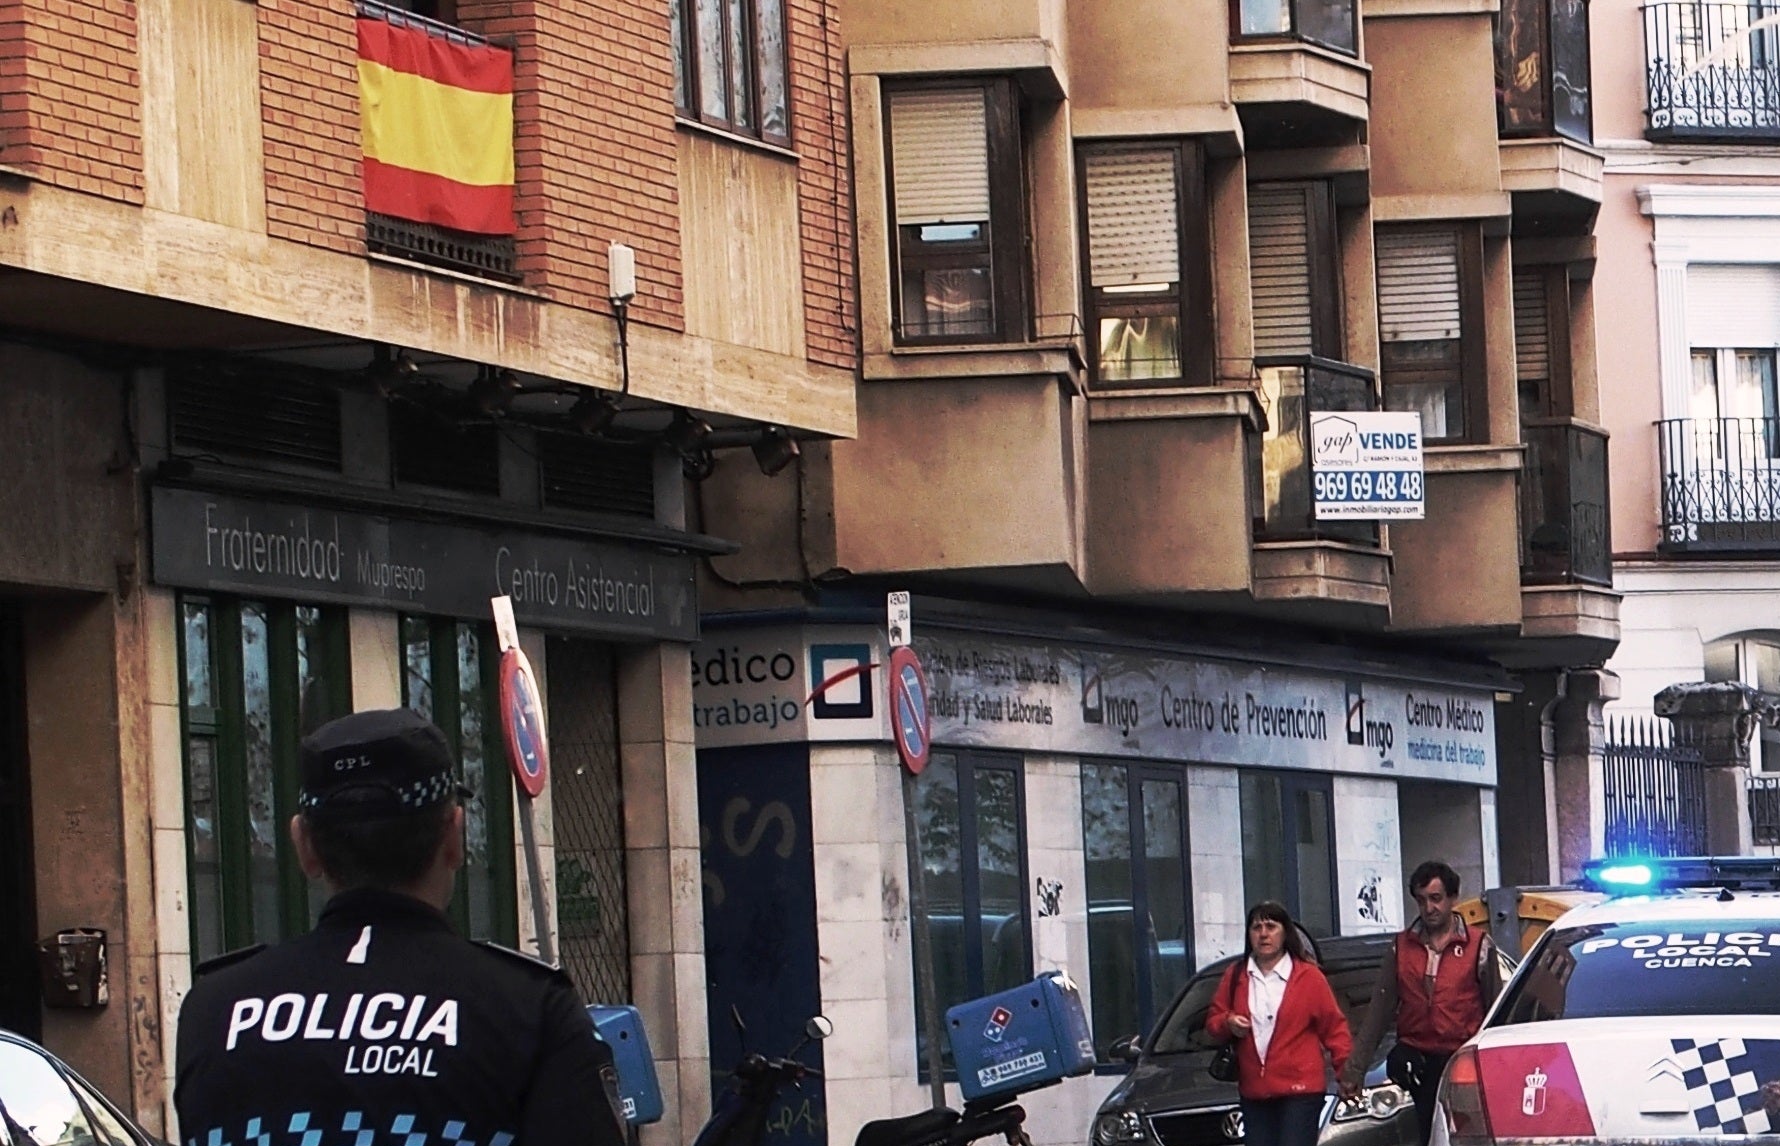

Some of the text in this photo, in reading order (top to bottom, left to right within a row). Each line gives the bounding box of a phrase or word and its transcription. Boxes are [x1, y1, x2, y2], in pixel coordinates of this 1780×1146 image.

[1317, 432, 1353, 454] gap
[1359, 433, 1417, 450] VENDE
[1315, 471, 1421, 500] 969 69 48 48
[206, 503, 340, 582] Fraternidad
[496, 547, 654, 616] Centro Asistencial
[693, 695, 798, 729] trabajo
[974, 692, 1003, 722] Salud
[1006, 696, 1053, 725] Laborales
[1104, 694, 1139, 737] mgo
[1161, 684, 1327, 741] Centro de Prevención
[1406, 693, 1443, 729] Centro
[1366, 719, 1394, 758] mgo
[1445, 740, 1457, 763] del
[334, 756, 371, 770] CPL
[1633, 946, 1771, 959] LOCAL
[1644, 957, 1753, 969] CUENCA
[226, 992, 459, 1051] POLICIA
[344, 1045, 439, 1077] LOCAL
